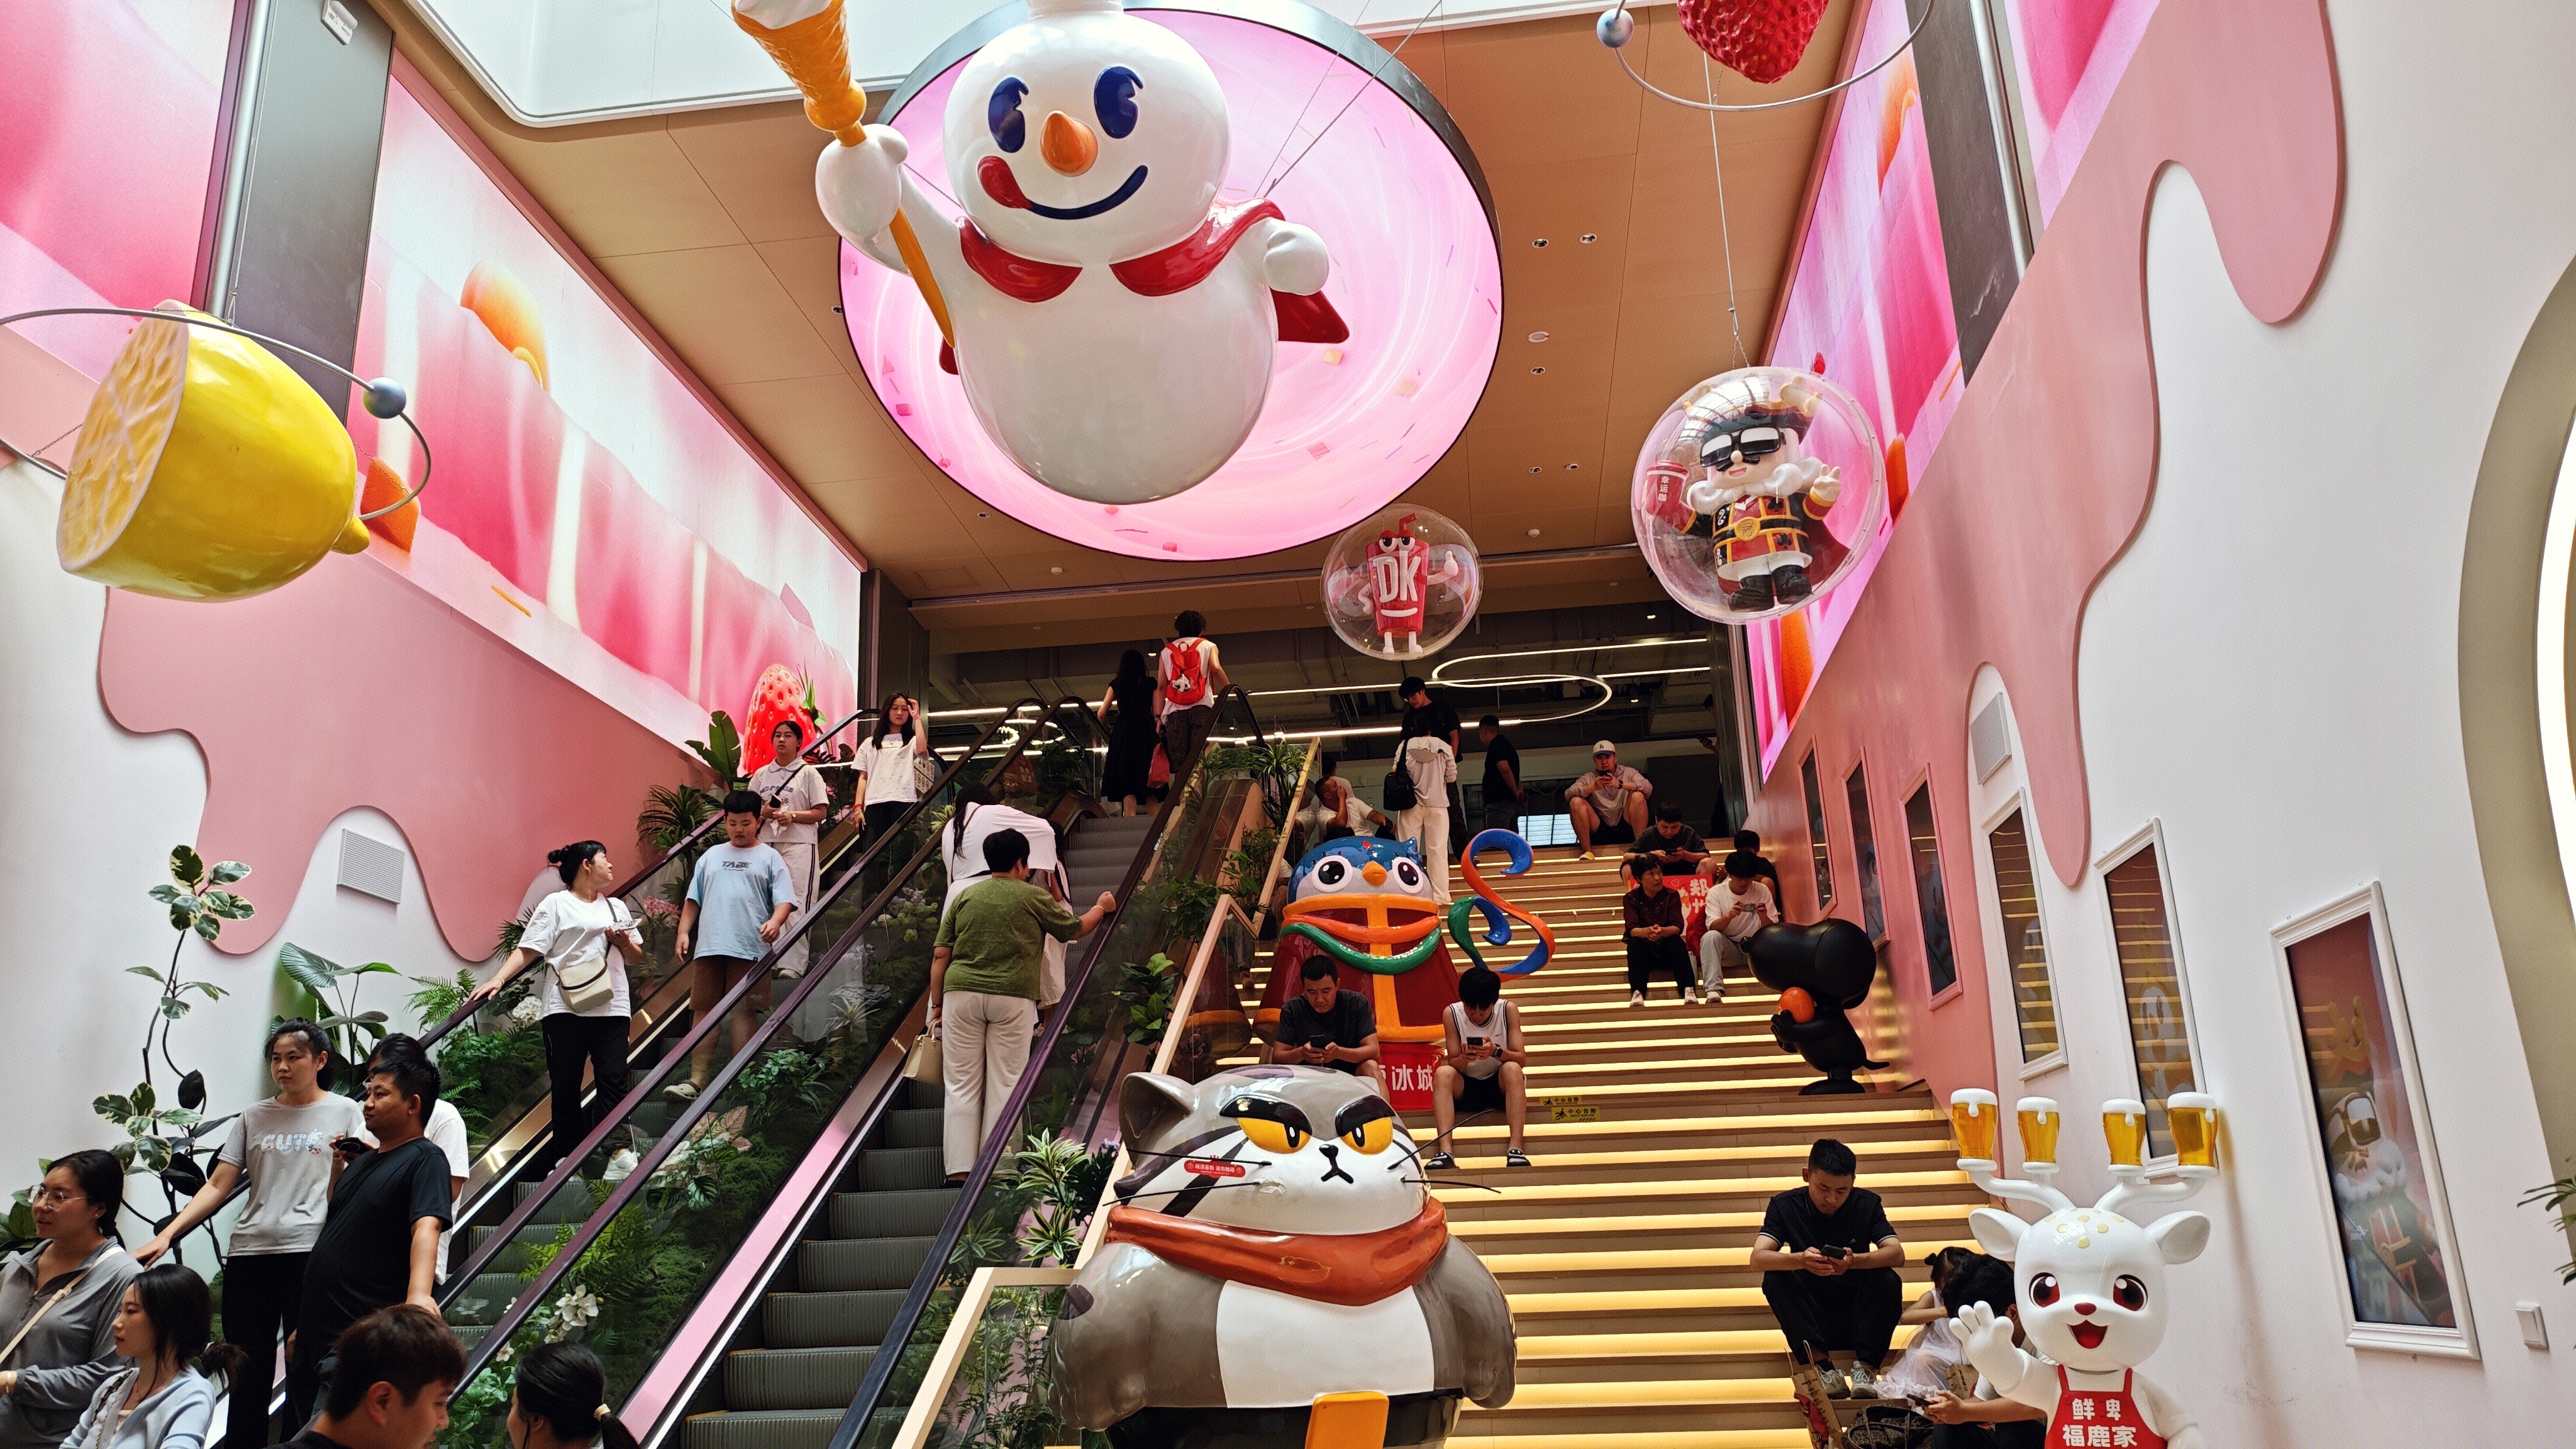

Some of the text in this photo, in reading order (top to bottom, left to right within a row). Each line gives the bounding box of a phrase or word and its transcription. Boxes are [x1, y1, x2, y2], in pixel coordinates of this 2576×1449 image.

[1658, 476, 1670, 501] 幸运咖
[1373, 552, 1421, 603] DK
[1379, 1063, 1433, 1092] 冰城
[2062, 1424, 2137, 1448] 福鹿家
